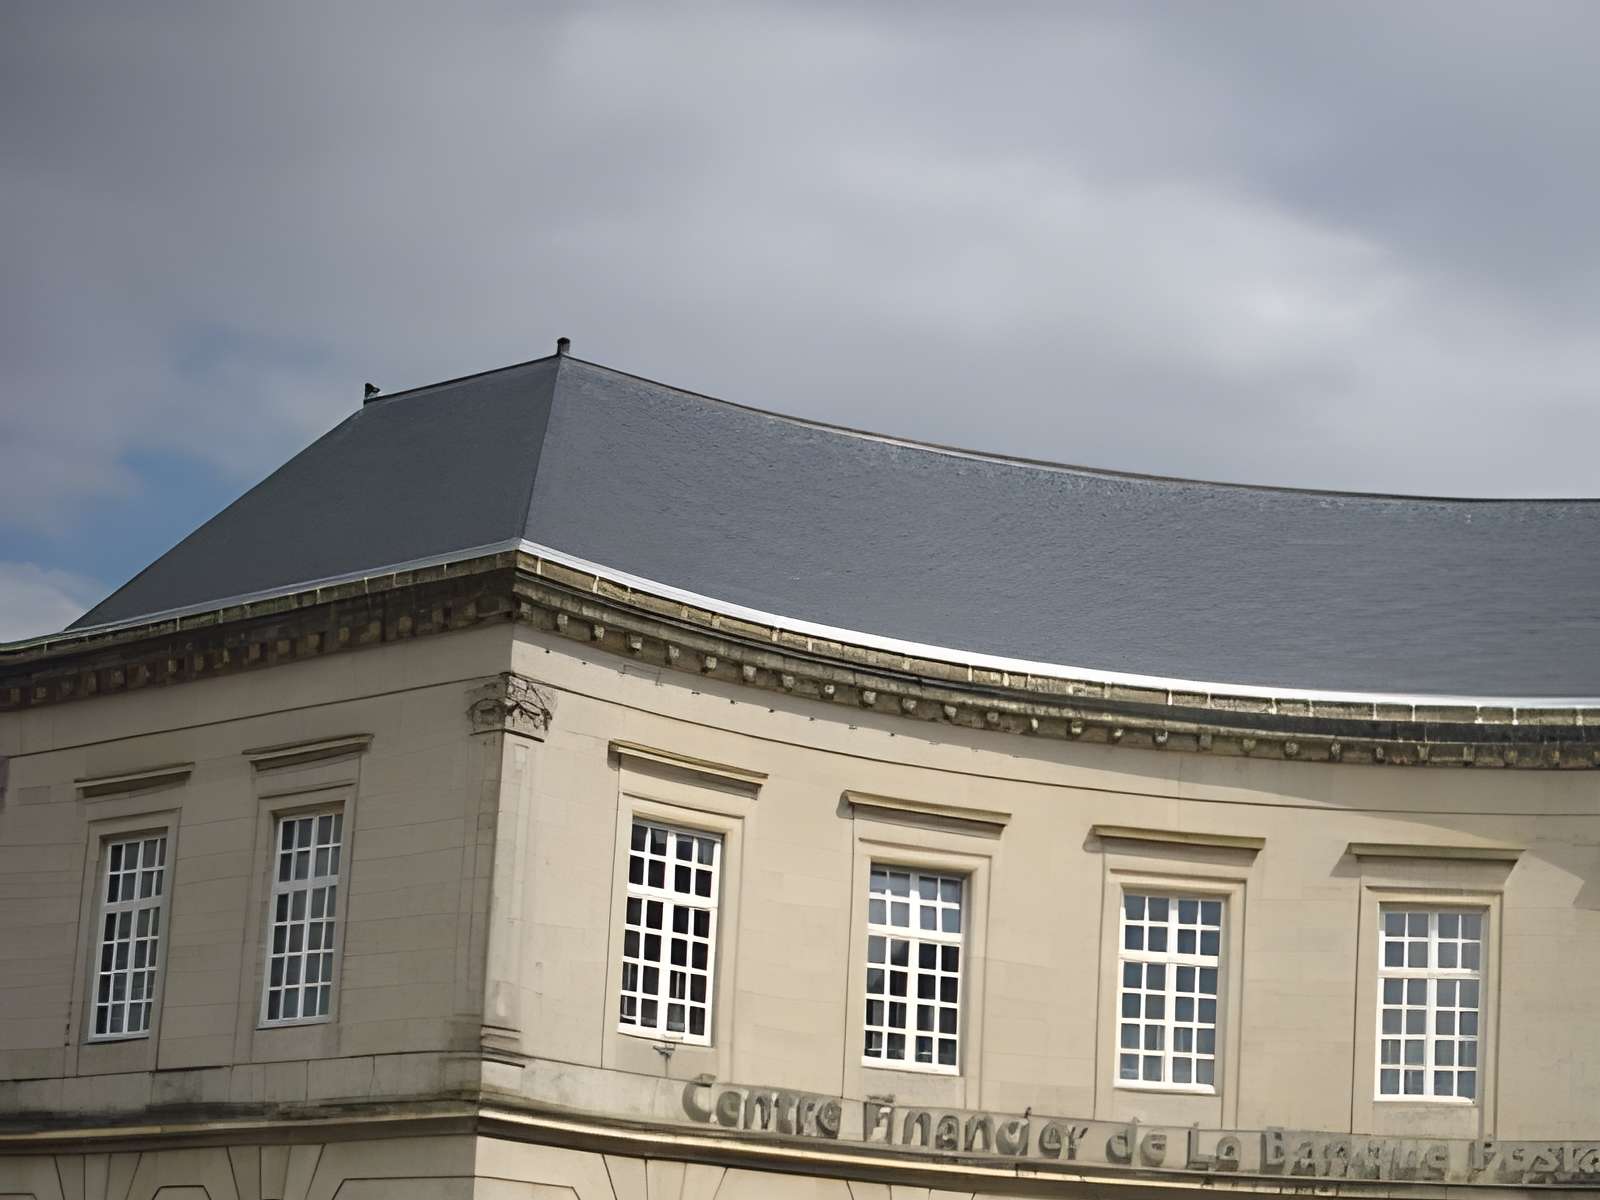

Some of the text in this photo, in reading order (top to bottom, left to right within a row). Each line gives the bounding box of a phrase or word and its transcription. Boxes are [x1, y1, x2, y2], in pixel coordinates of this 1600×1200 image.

[682, 1073, 842, 1139] Centre
[1105, 1117, 1167, 1168] de
[1186, 1122, 1242, 1172] La
